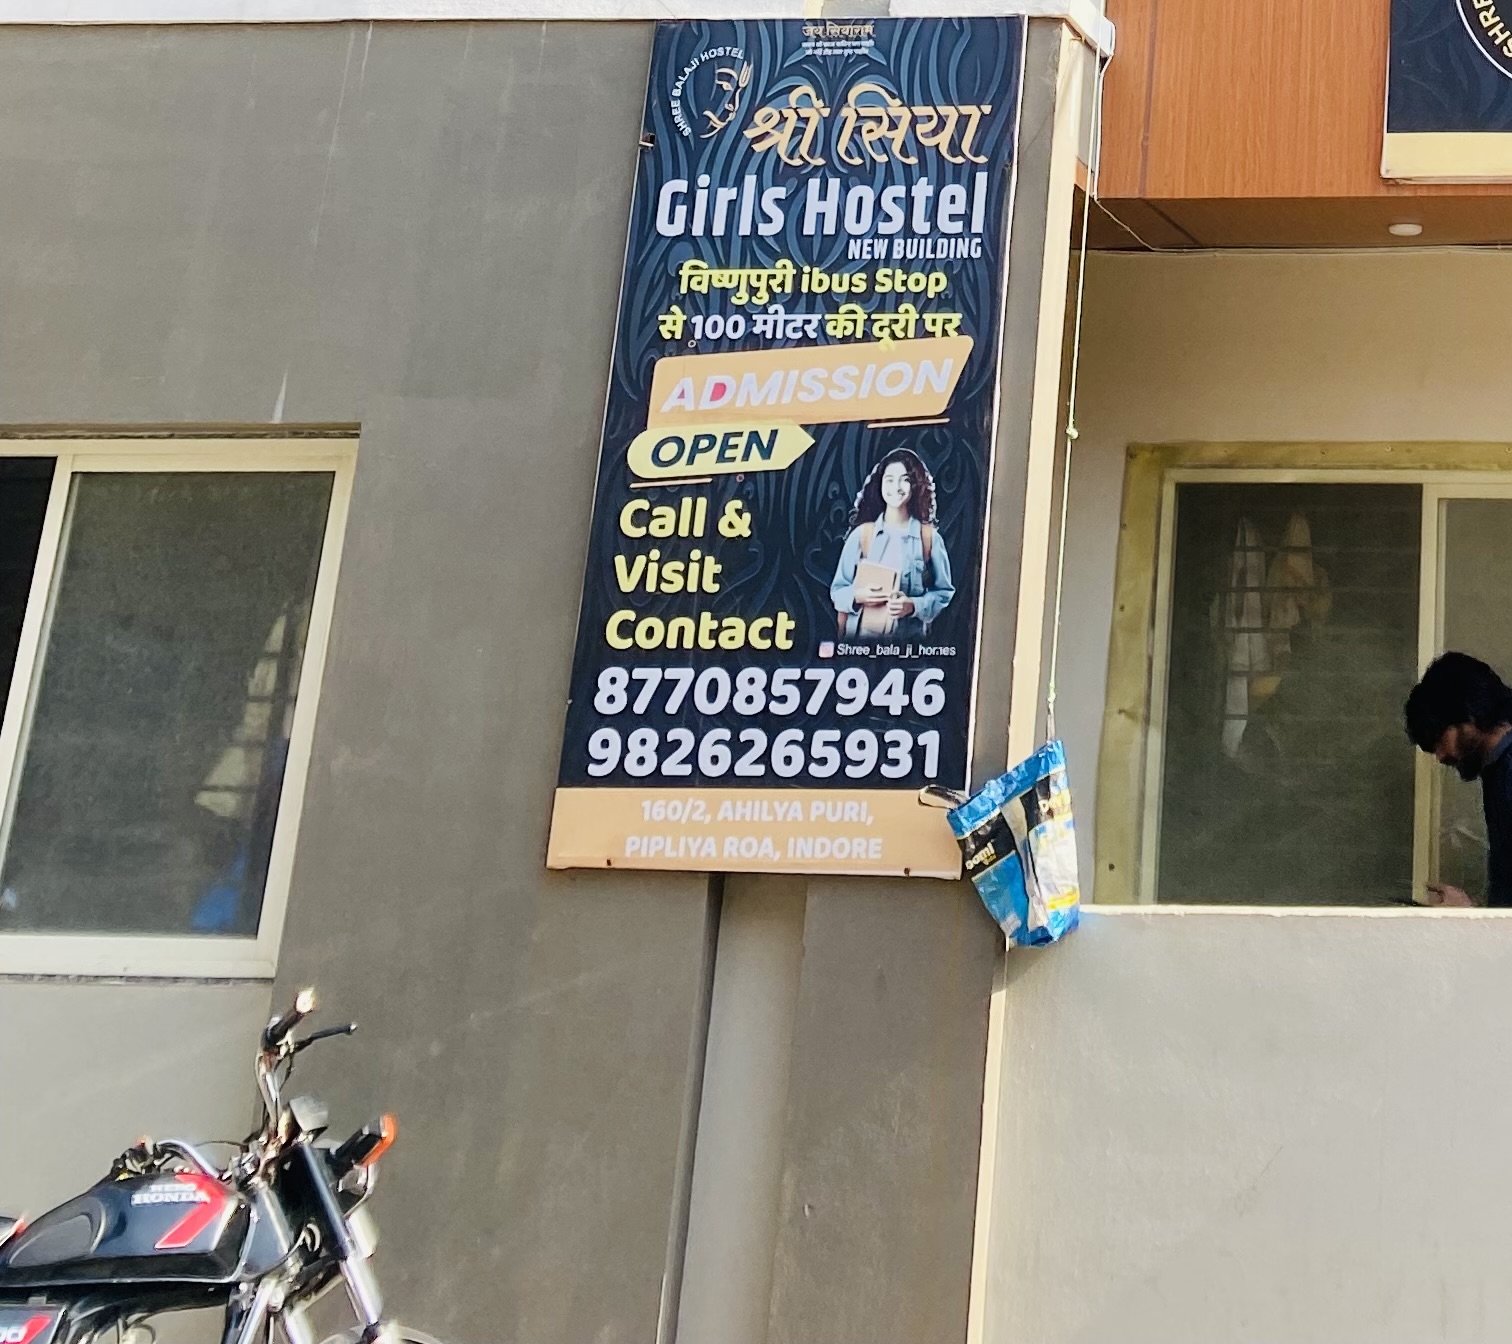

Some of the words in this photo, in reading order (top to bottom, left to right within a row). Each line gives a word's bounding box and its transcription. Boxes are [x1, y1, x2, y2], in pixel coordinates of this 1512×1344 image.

[700, 46, 744, 62] HOSTEL
[671, 58, 700, 97] BALAJI
[671, 99, 692, 137] SHREE
[743, 85, 832, 167] श्री
[836, 83, 993, 166] सिया
[655, 174, 787, 238] Girls
[802, 171, 989, 236] Hostel
[847, 238, 888, 260] NEW
[892, 237, 982, 259] BUILDING
[678, 258, 796, 305] विष्णुपुरी
[800, 265, 867, 294] ibus
[874, 267, 948, 299] Stop
[657, 304, 687, 340] से
[690, 314, 746, 340] 100
[752, 303, 822, 340] मीटर
[825, 302, 867, 340] की
[871, 302, 920, 352] दूरी
[922, 312, 963, 338] पर
[660, 358, 956, 413] ADMISSION
[650, 429, 780, 468] OPEN
[619, 496, 705, 539] Call
[717, 497, 752, 539] &
[613, 549, 723, 594] Visit
[605, 610, 796, 650] Contact
[593, 667, 946, 716] 8770857946
[586, 728, 942, 779] 9826265931
[640, 797, 711, 825] 160/2,
[716, 800, 804, 823] AHILYA
[809, 800, 875, 827] PURI,
[624, 836, 717, 859] PIPLIYA
[722, 837, 781, 862] ROA,
[787, 838, 883, 860] INDORE
